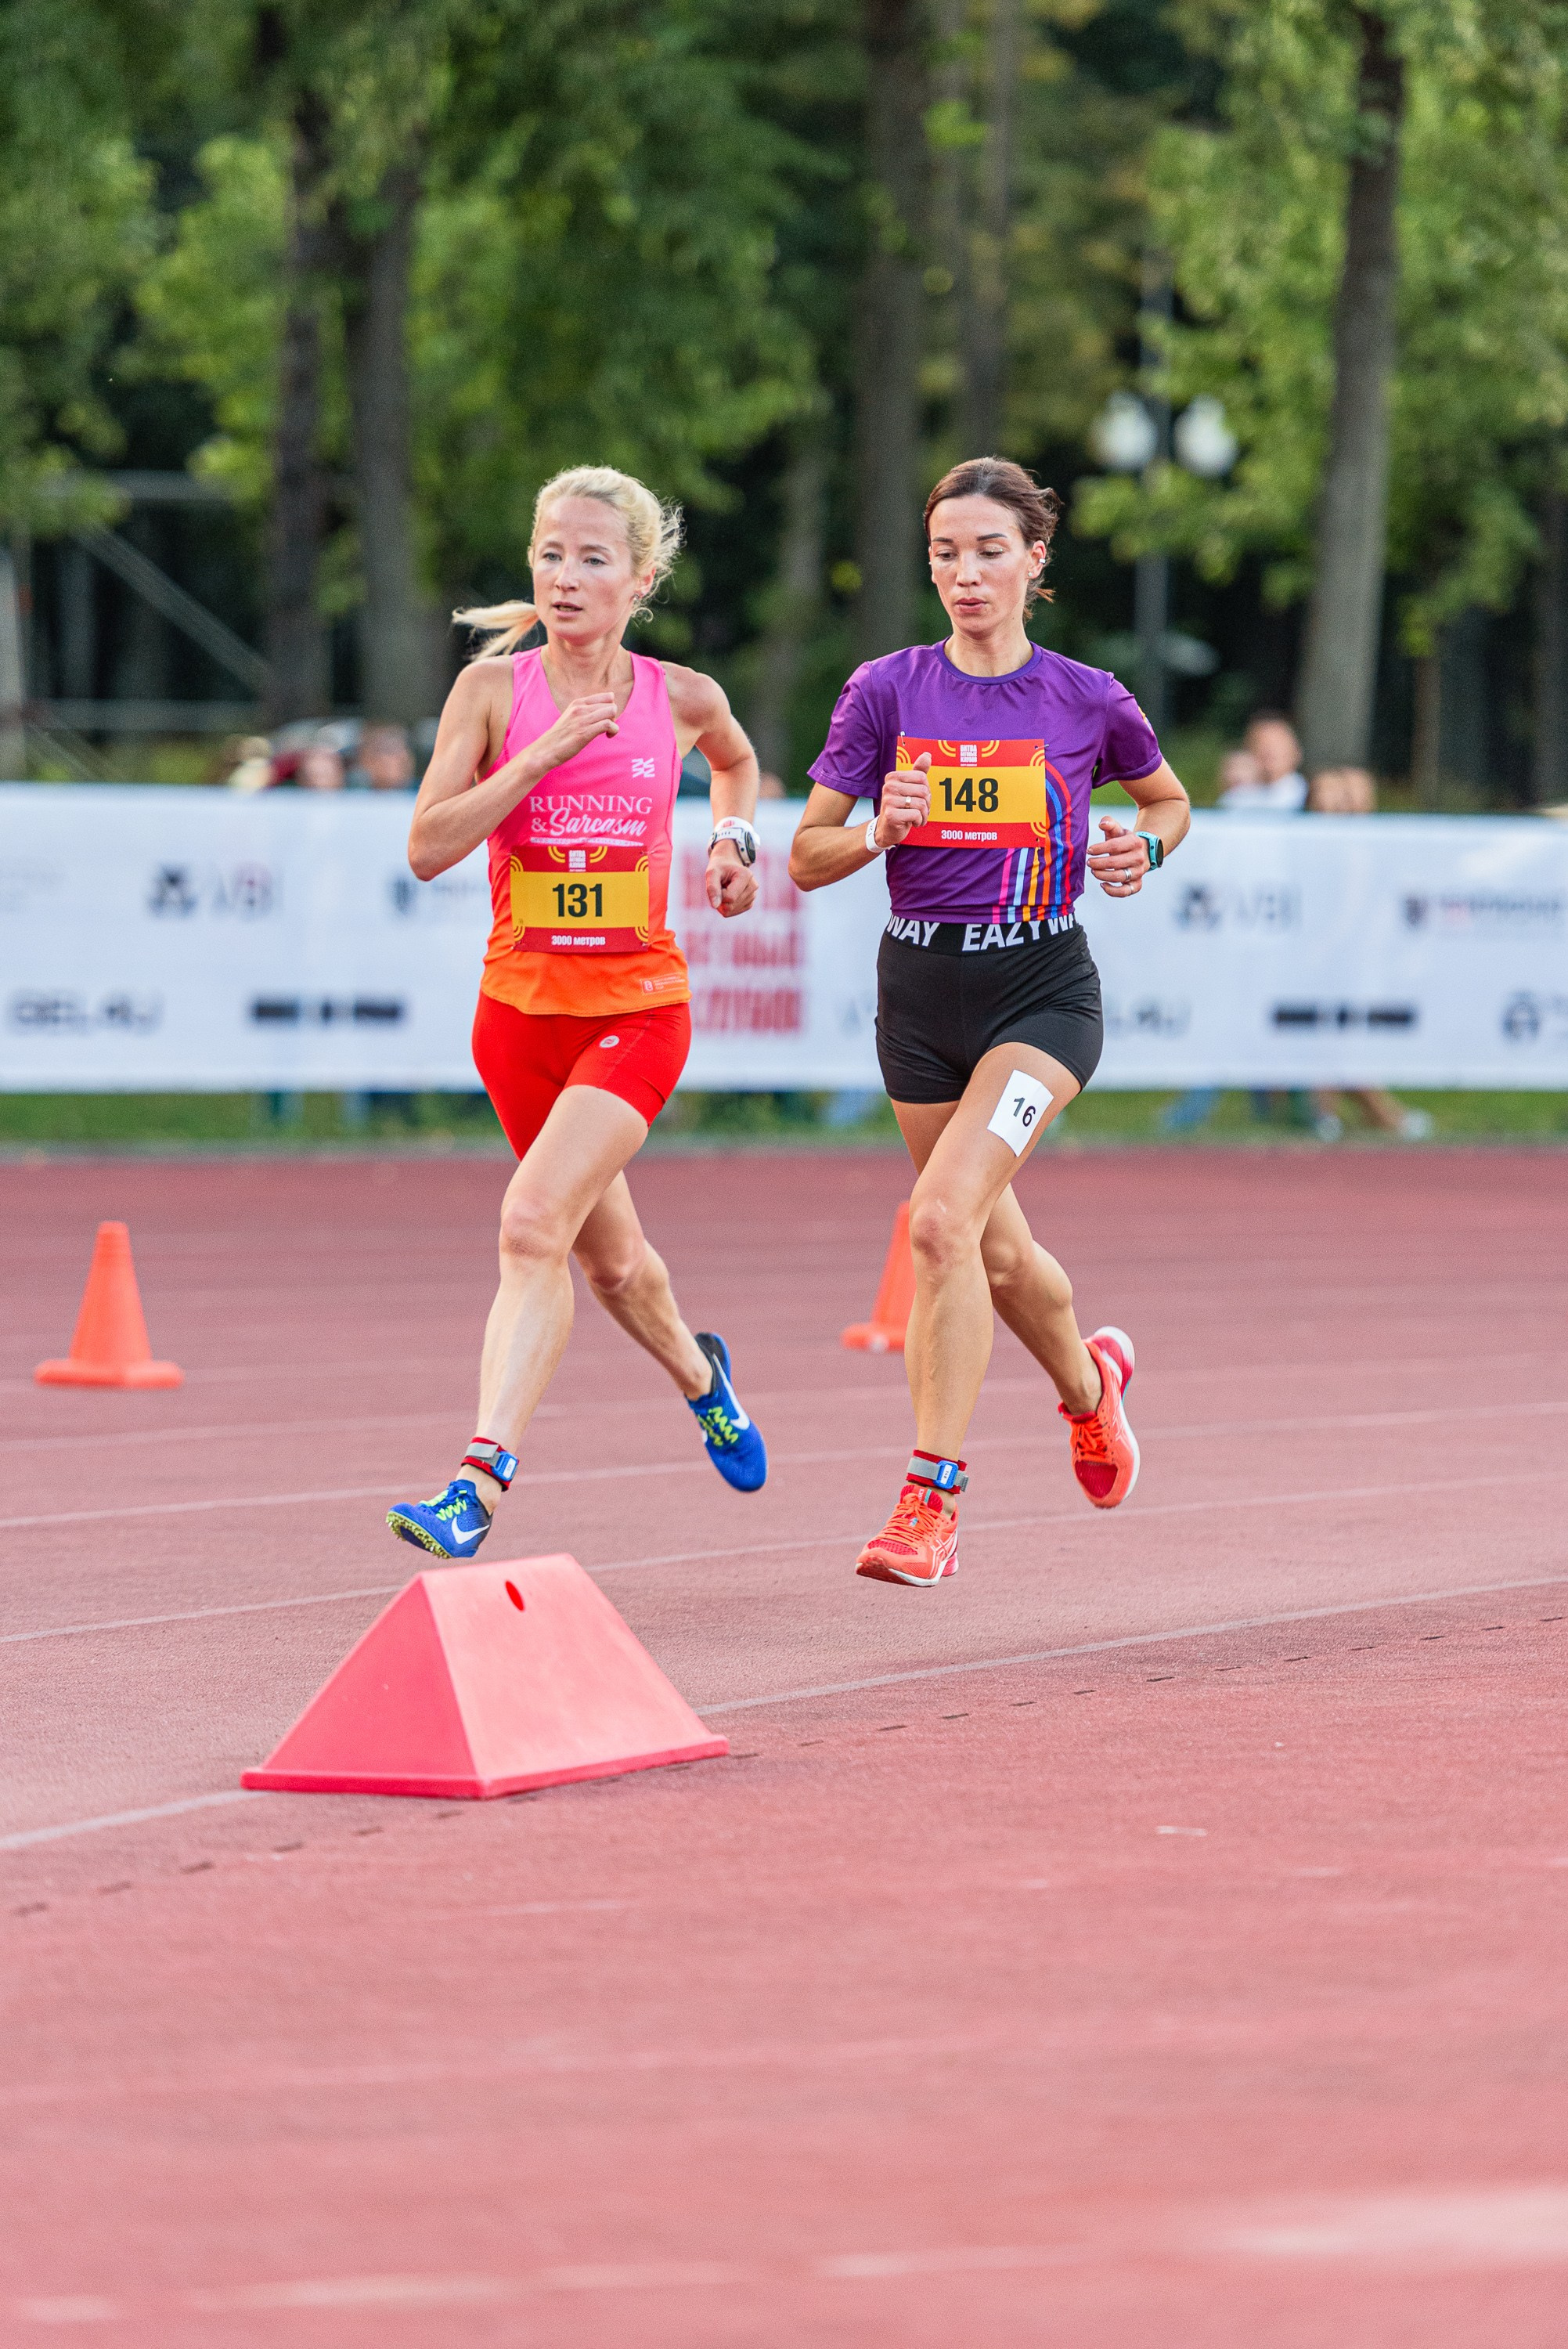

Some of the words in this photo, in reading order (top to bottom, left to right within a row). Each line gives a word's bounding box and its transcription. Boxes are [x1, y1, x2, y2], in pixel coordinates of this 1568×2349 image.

[528, 795, 653, 814] RUNNING
[939, 778, 999, 813] 148
[531, 817, 548, 832] &
[550, 806, 647, 836] Sarcasm
[941, 829, 964, 840] 3000
[964, 832, 998, 843] метров
[553, 883, 602, 918] 131
[551, 935, 572, 946] 3000
[573, 936, 606, 947] метров
[1013, 1097, 1036, 1127] 16
